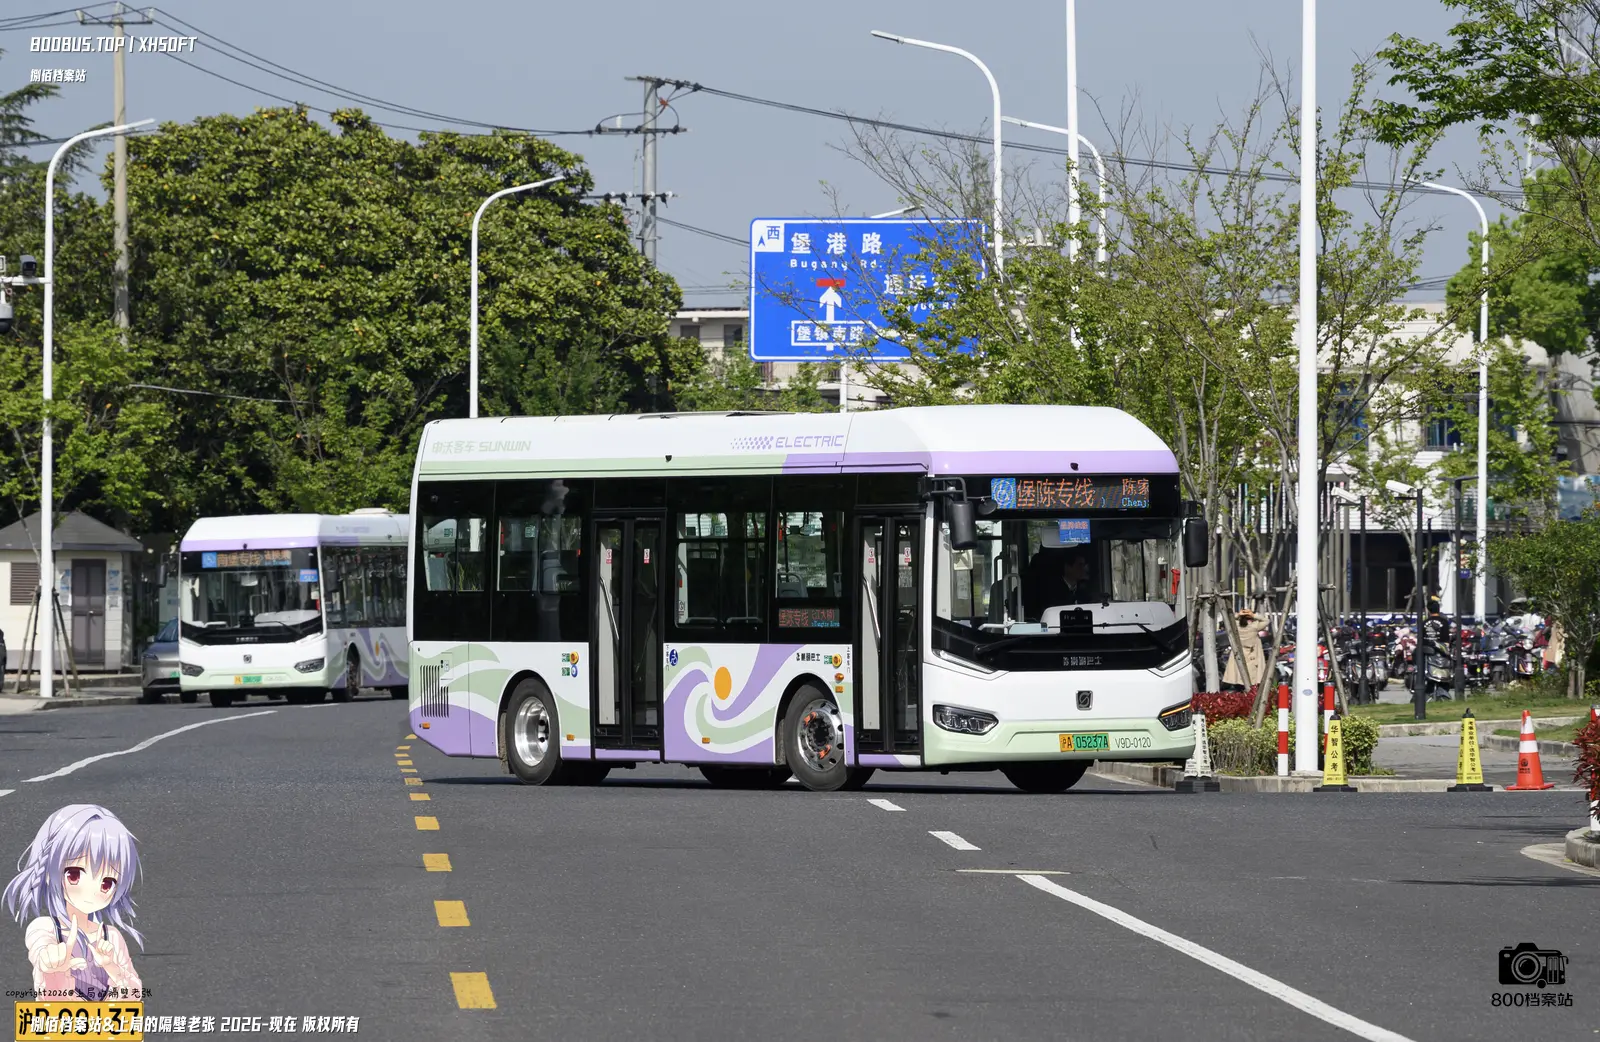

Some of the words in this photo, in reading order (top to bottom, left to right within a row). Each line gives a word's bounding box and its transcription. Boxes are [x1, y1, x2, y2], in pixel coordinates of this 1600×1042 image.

[767, 226, 780, 240] 西
[791, 232, 883, 254] 堡港路
[790, 259, 848, 270] Bugang
[432, 440, 476, 454] 申沃客车
[479, 440, 532, 452] SUNWIN
[775, 435, 844, 448] ELECTRIC
[1017, 478, 1096, 508] 堡陈专线
[1122, 478, 1149, 496] 陈家
[1075, 735, 1109, 749] 05237A
[1115, 738, 1151, 748] V9D-0120
[1330, 725, 1339, 772] 华智公考
